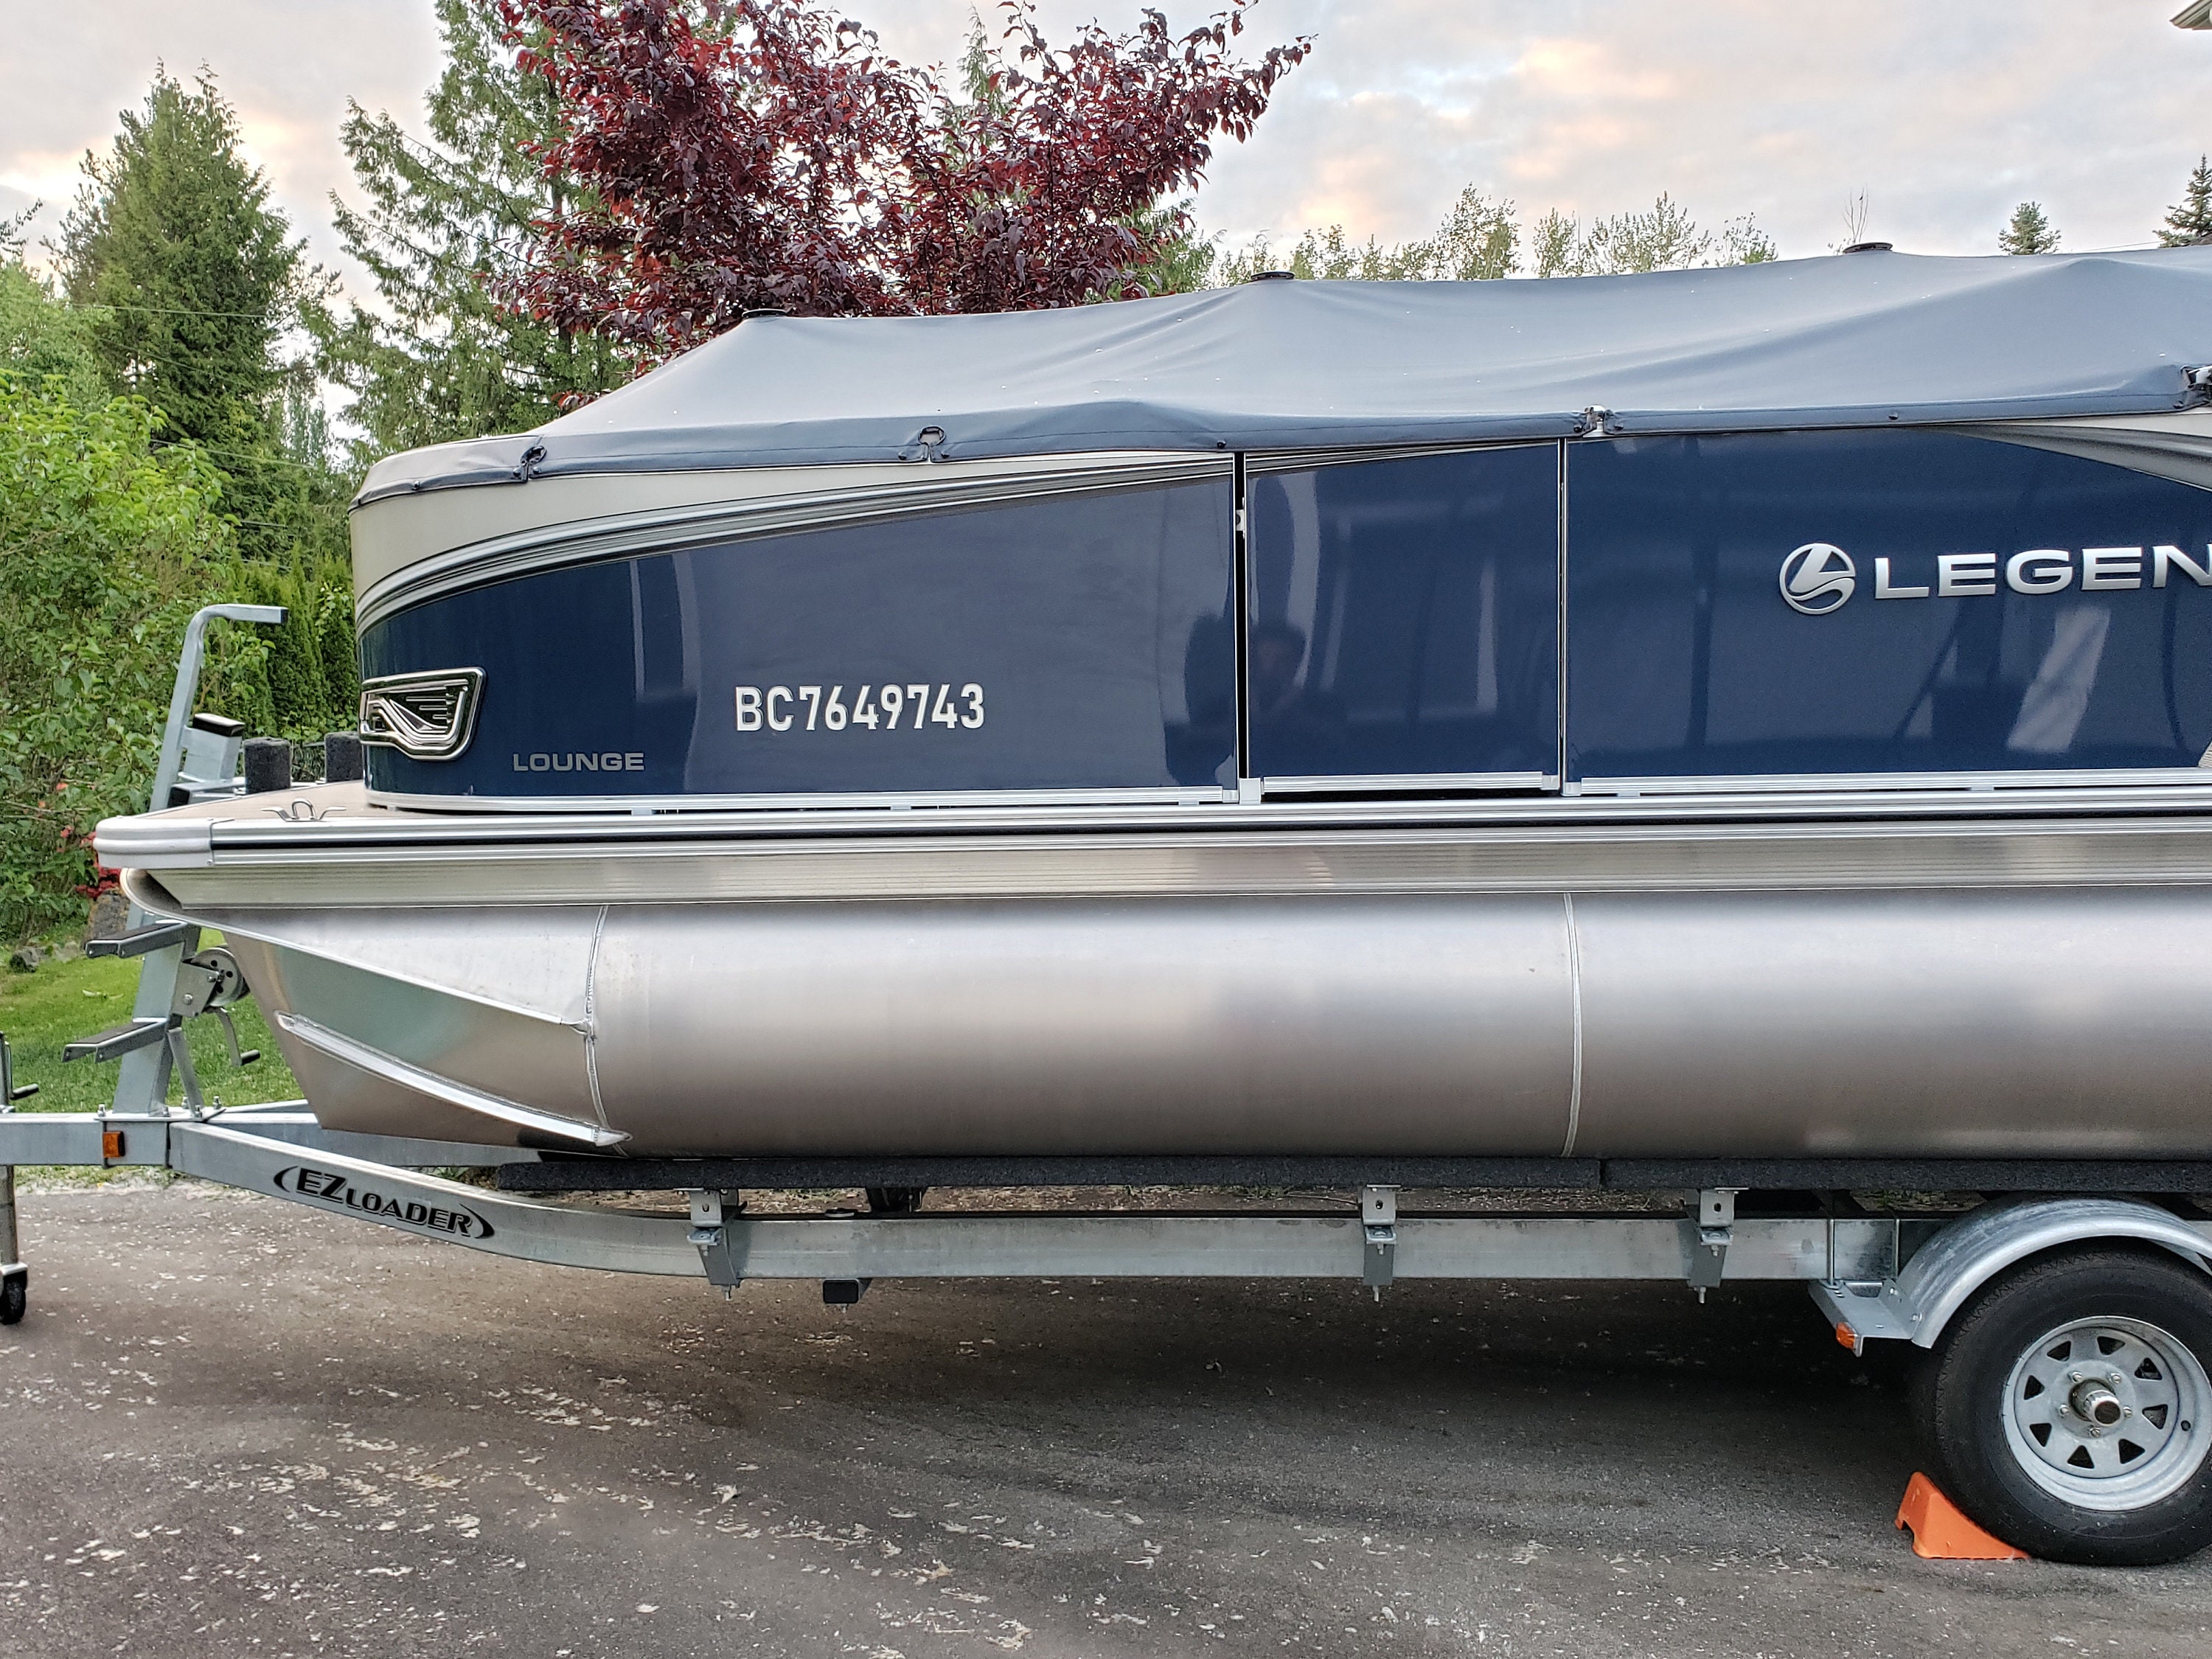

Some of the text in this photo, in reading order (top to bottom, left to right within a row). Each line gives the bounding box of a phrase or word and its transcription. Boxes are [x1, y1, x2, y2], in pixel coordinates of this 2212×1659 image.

[1874, 543, 2212, 599] LEGEN
[735, 683, 985, 731] BC7649743
[513, 752, 644, 771] LOUNGE
